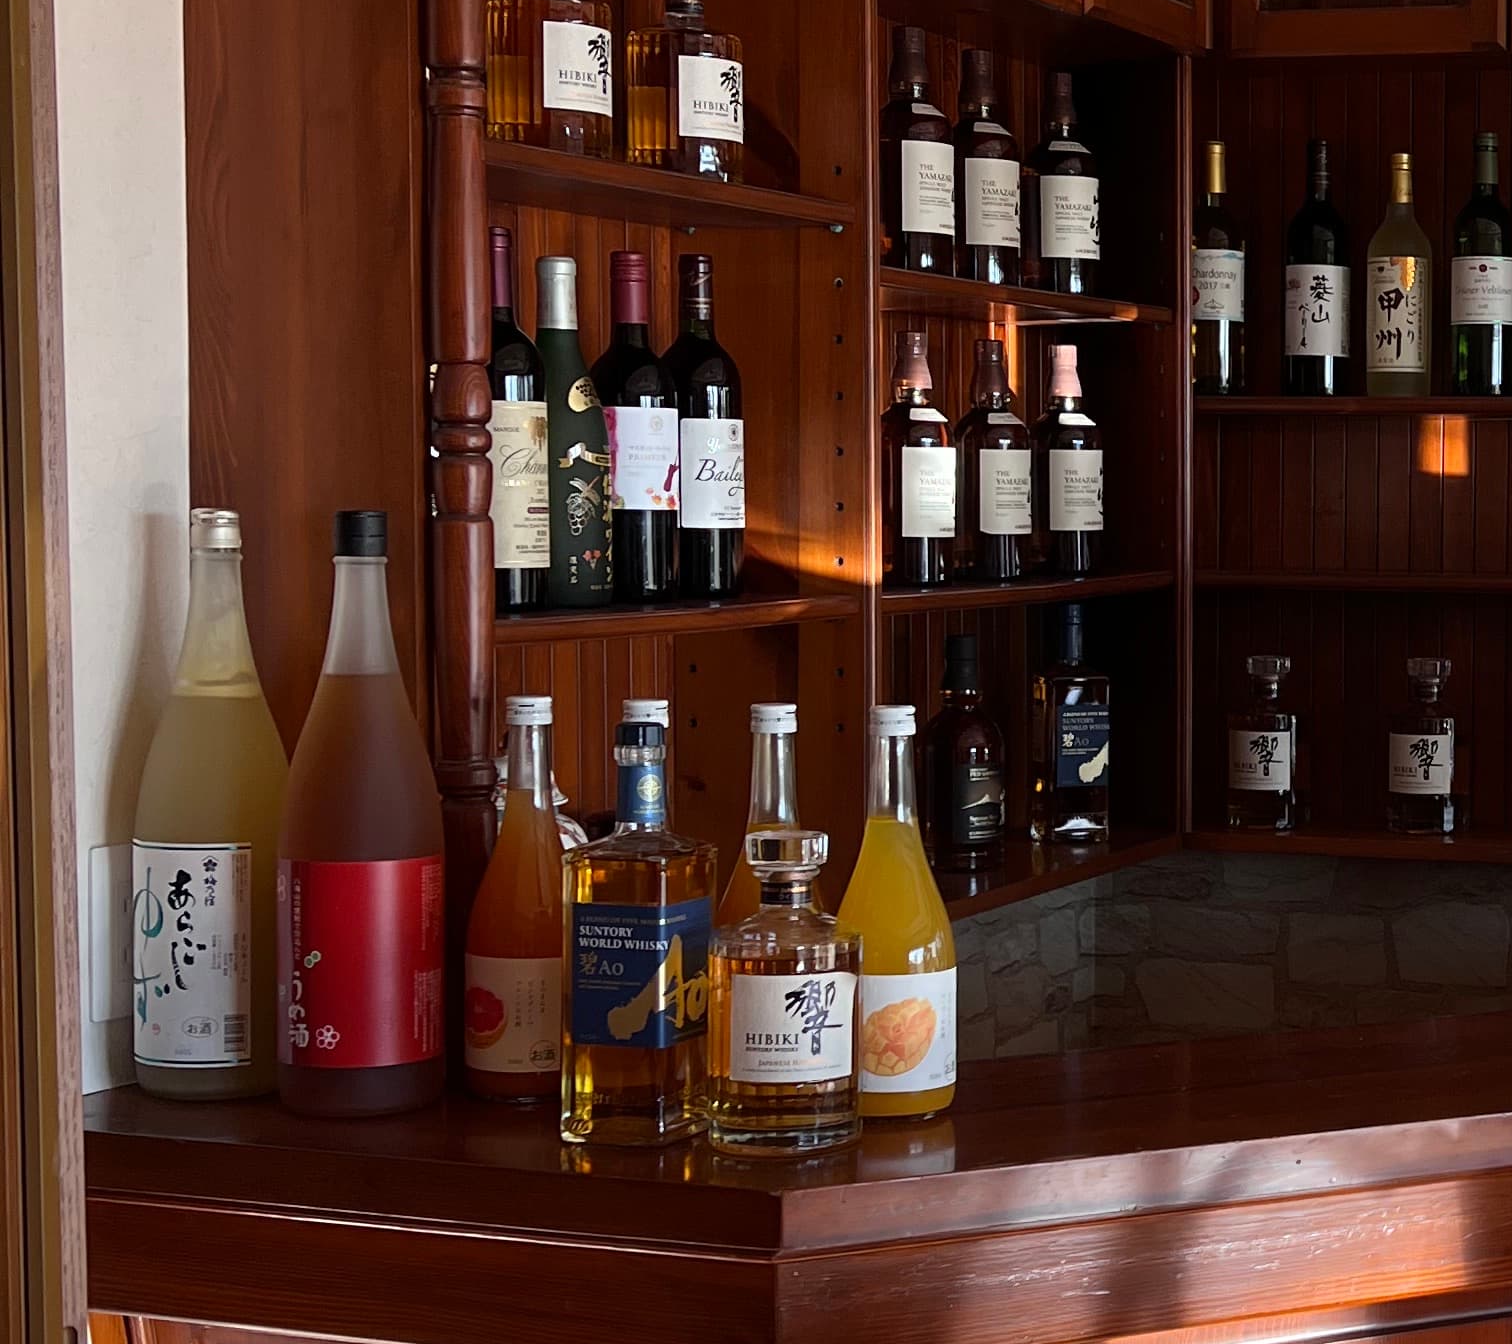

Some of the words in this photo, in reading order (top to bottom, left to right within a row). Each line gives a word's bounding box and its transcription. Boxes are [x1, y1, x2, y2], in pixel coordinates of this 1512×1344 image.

[559, 69, 597, 83] HIBIKI
[693, 100, 730, 113] HIBIKI
[1375, 288, 1404, 360] 甲州
[579, 925, 634, 937] SUNTORY
[579, 938, 622, 949] WORLD
[624, 940, 669, 951] WHISKY
[578, 951, 597, 975] 碧
[599, 961, 624, 976] Ao
[785, 979, 844, 1055] 響
[745, 1033, 799, 1045] HIBIKI
